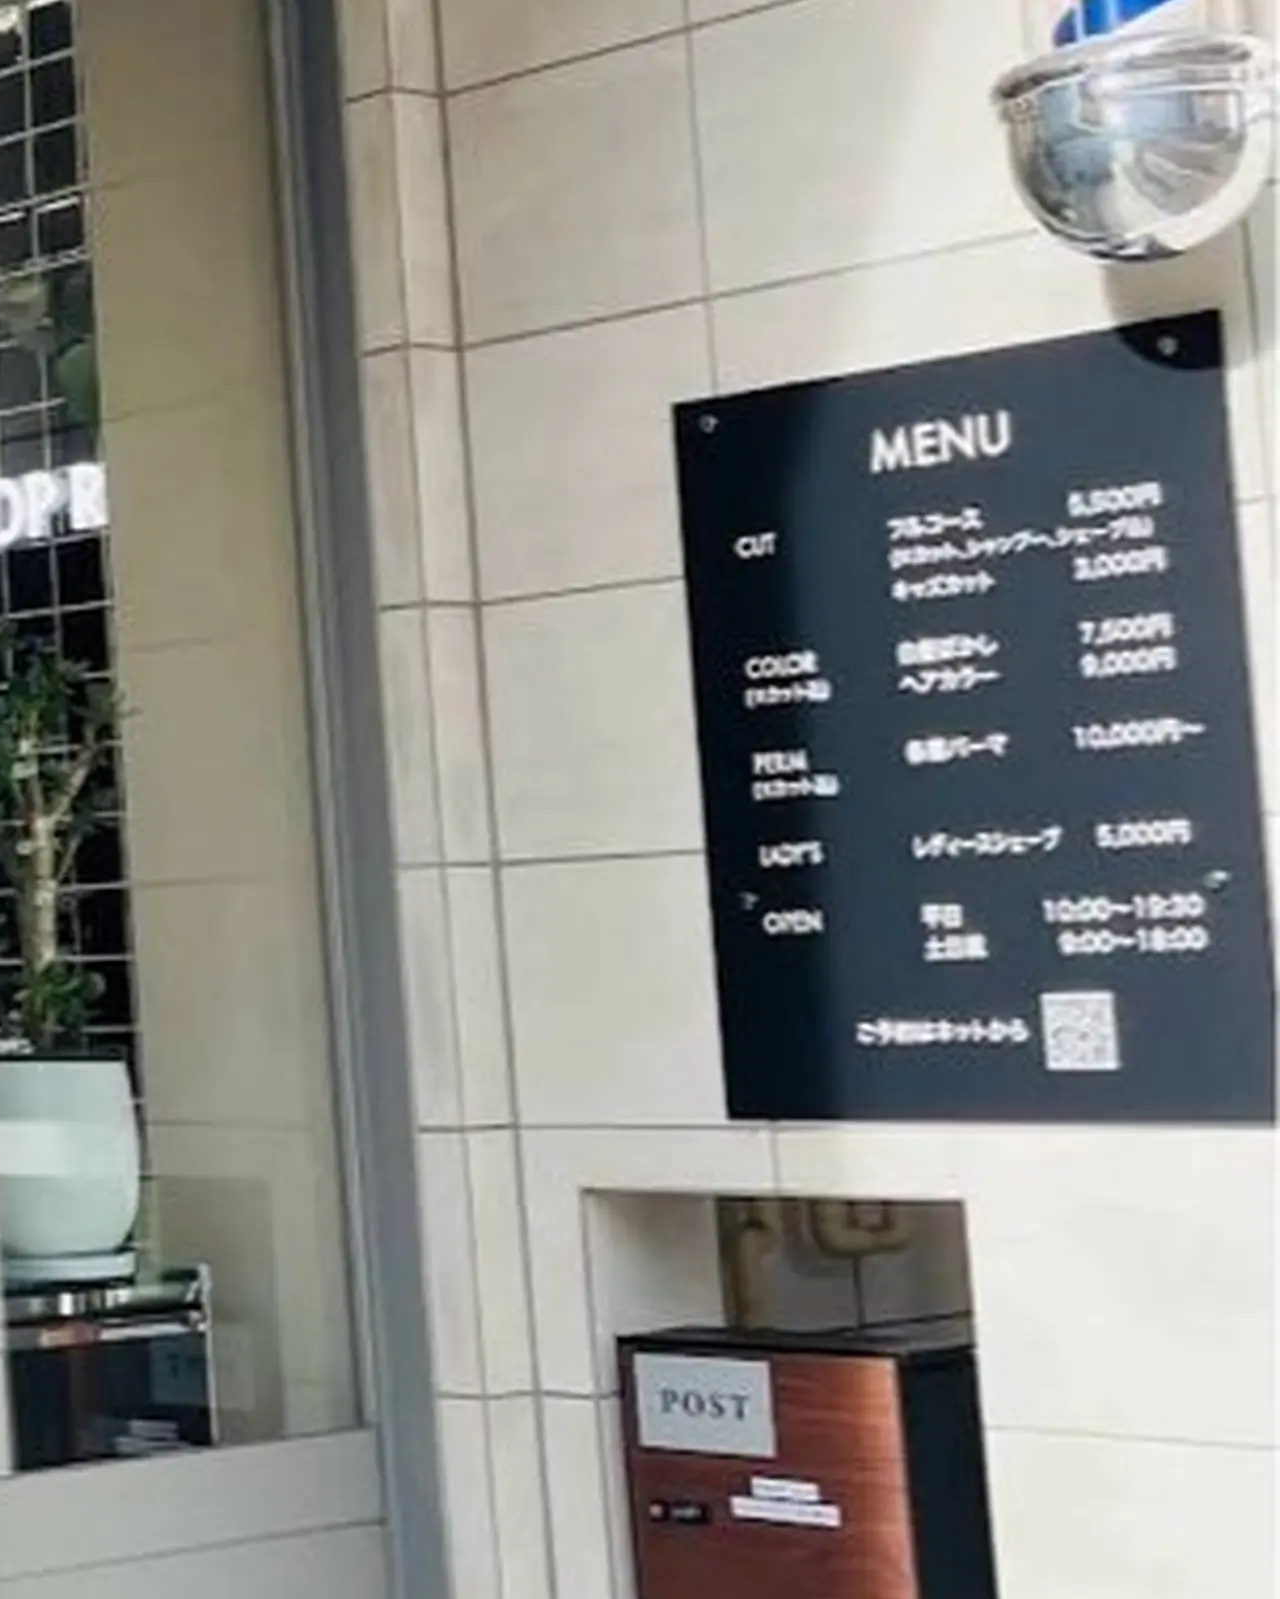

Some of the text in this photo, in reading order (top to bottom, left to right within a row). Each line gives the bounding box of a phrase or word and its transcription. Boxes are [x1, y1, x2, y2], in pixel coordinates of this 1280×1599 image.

[869, 409, 1012, 474] MENU
[733, 530, 778, 560] CUT
[743, 649, 820, 680] COLOR
[761, 908, 825, 936] OPEN
[658, 1386, 751, 1422] POST
